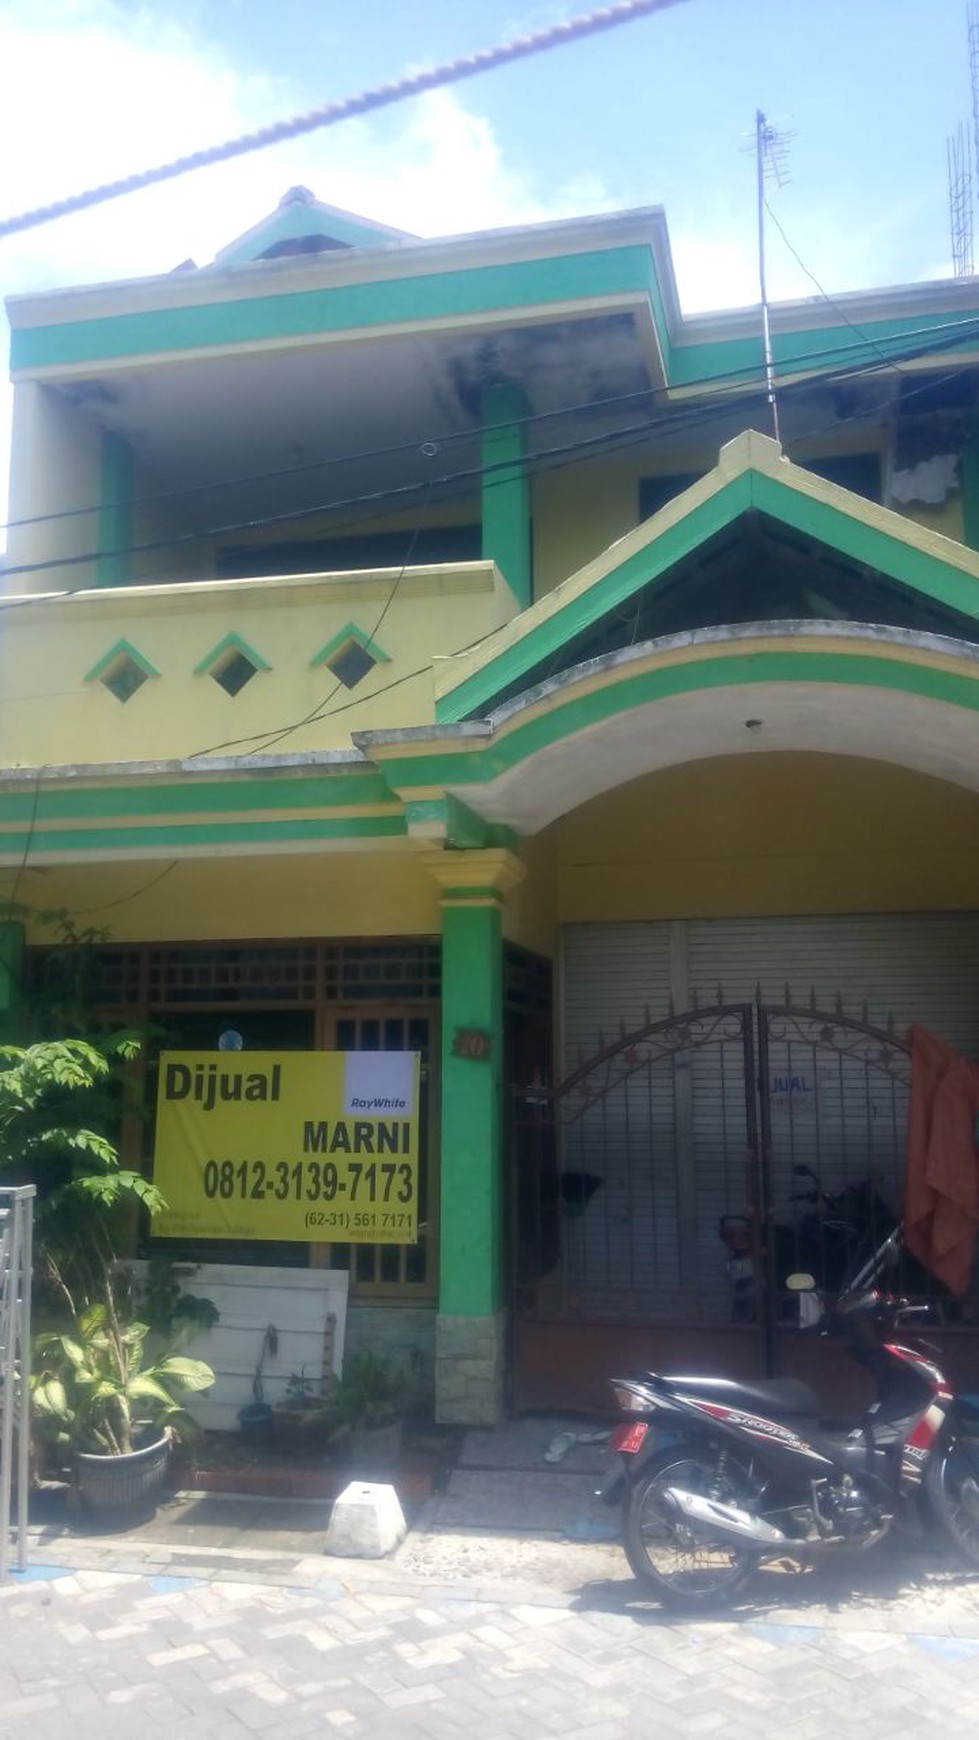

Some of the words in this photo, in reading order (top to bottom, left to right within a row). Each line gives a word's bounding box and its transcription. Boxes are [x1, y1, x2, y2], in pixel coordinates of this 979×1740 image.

[165, 1063, 282, 1111] Dijual
[757, 1076, 813, 1093] JUAL
[303, 1121, 410, 1154] MARNI
[204, 1159, 413, 1203] 0812-3139-7173
[305, 1212, 350, 1229] (62-31)
[354, 1213, 376, 1227] 561
[381, 1213, 412, 1228] 7171
